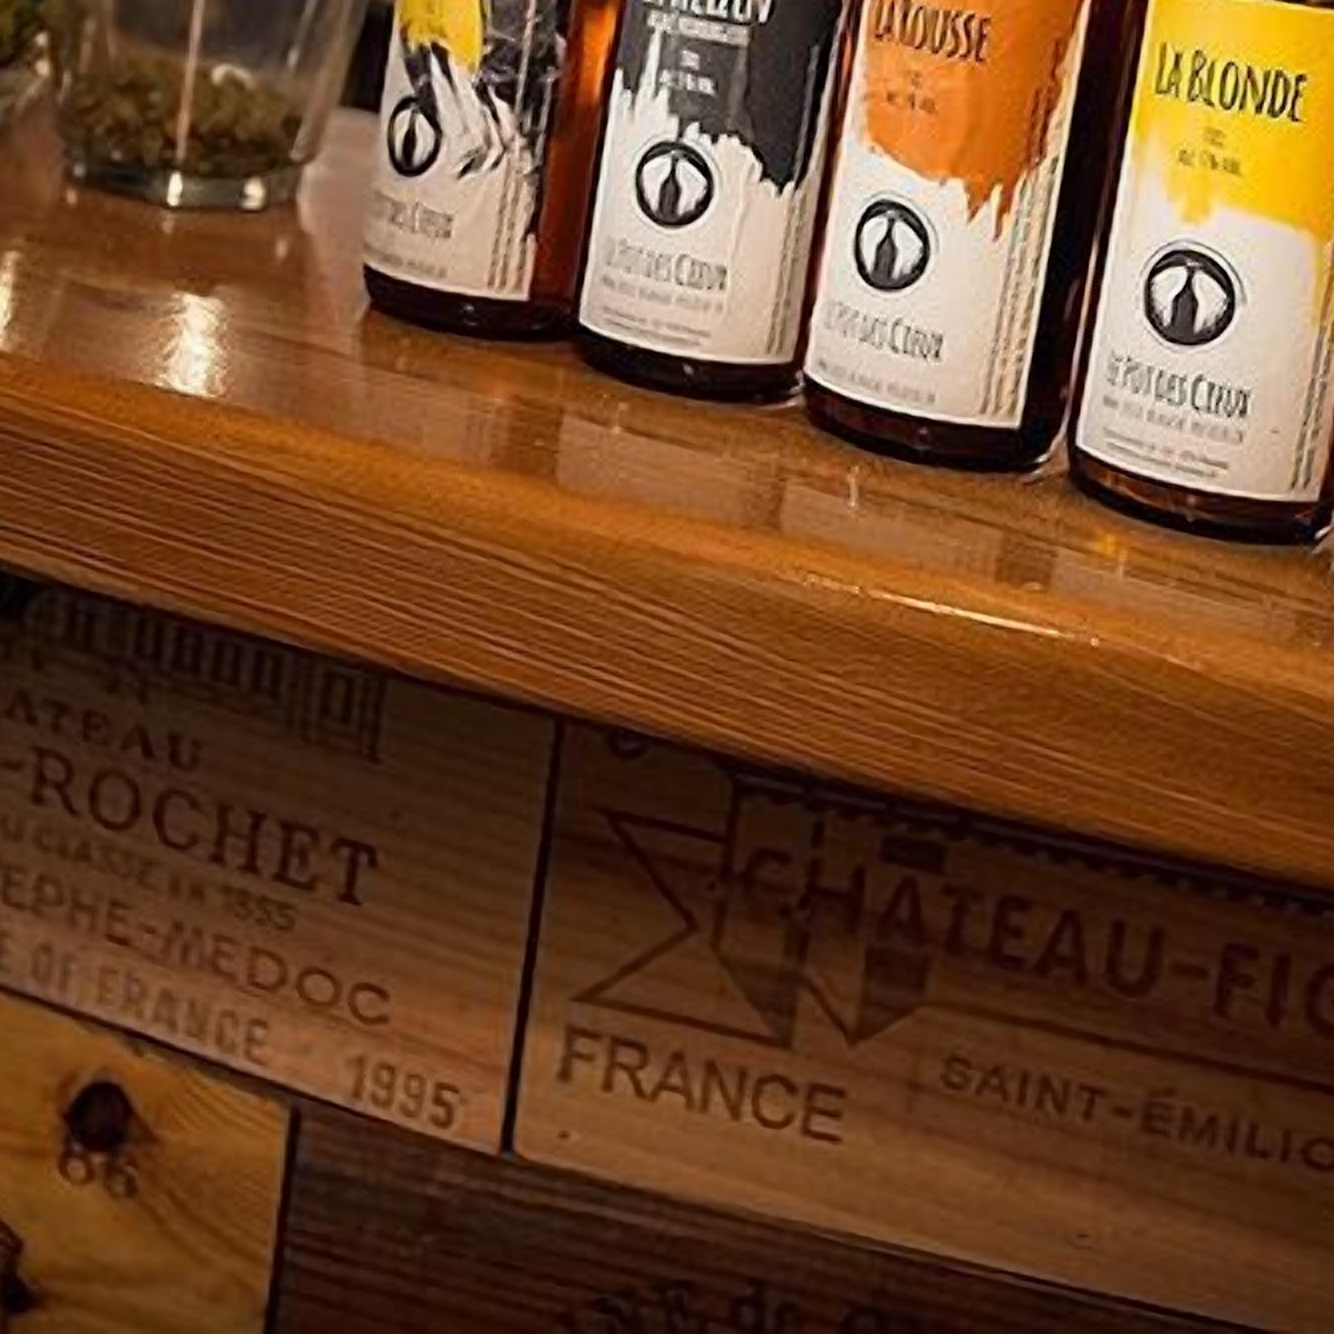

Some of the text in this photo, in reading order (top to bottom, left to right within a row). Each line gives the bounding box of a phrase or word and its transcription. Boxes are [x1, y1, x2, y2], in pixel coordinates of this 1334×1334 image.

[1154, 42, 1308, 123] LA BLONDE
[97, 970, 269, 1063] FRANCE
[346, 1053, 463, 1130] 1995
[555, 1022, 847, 1145] FRANCE
